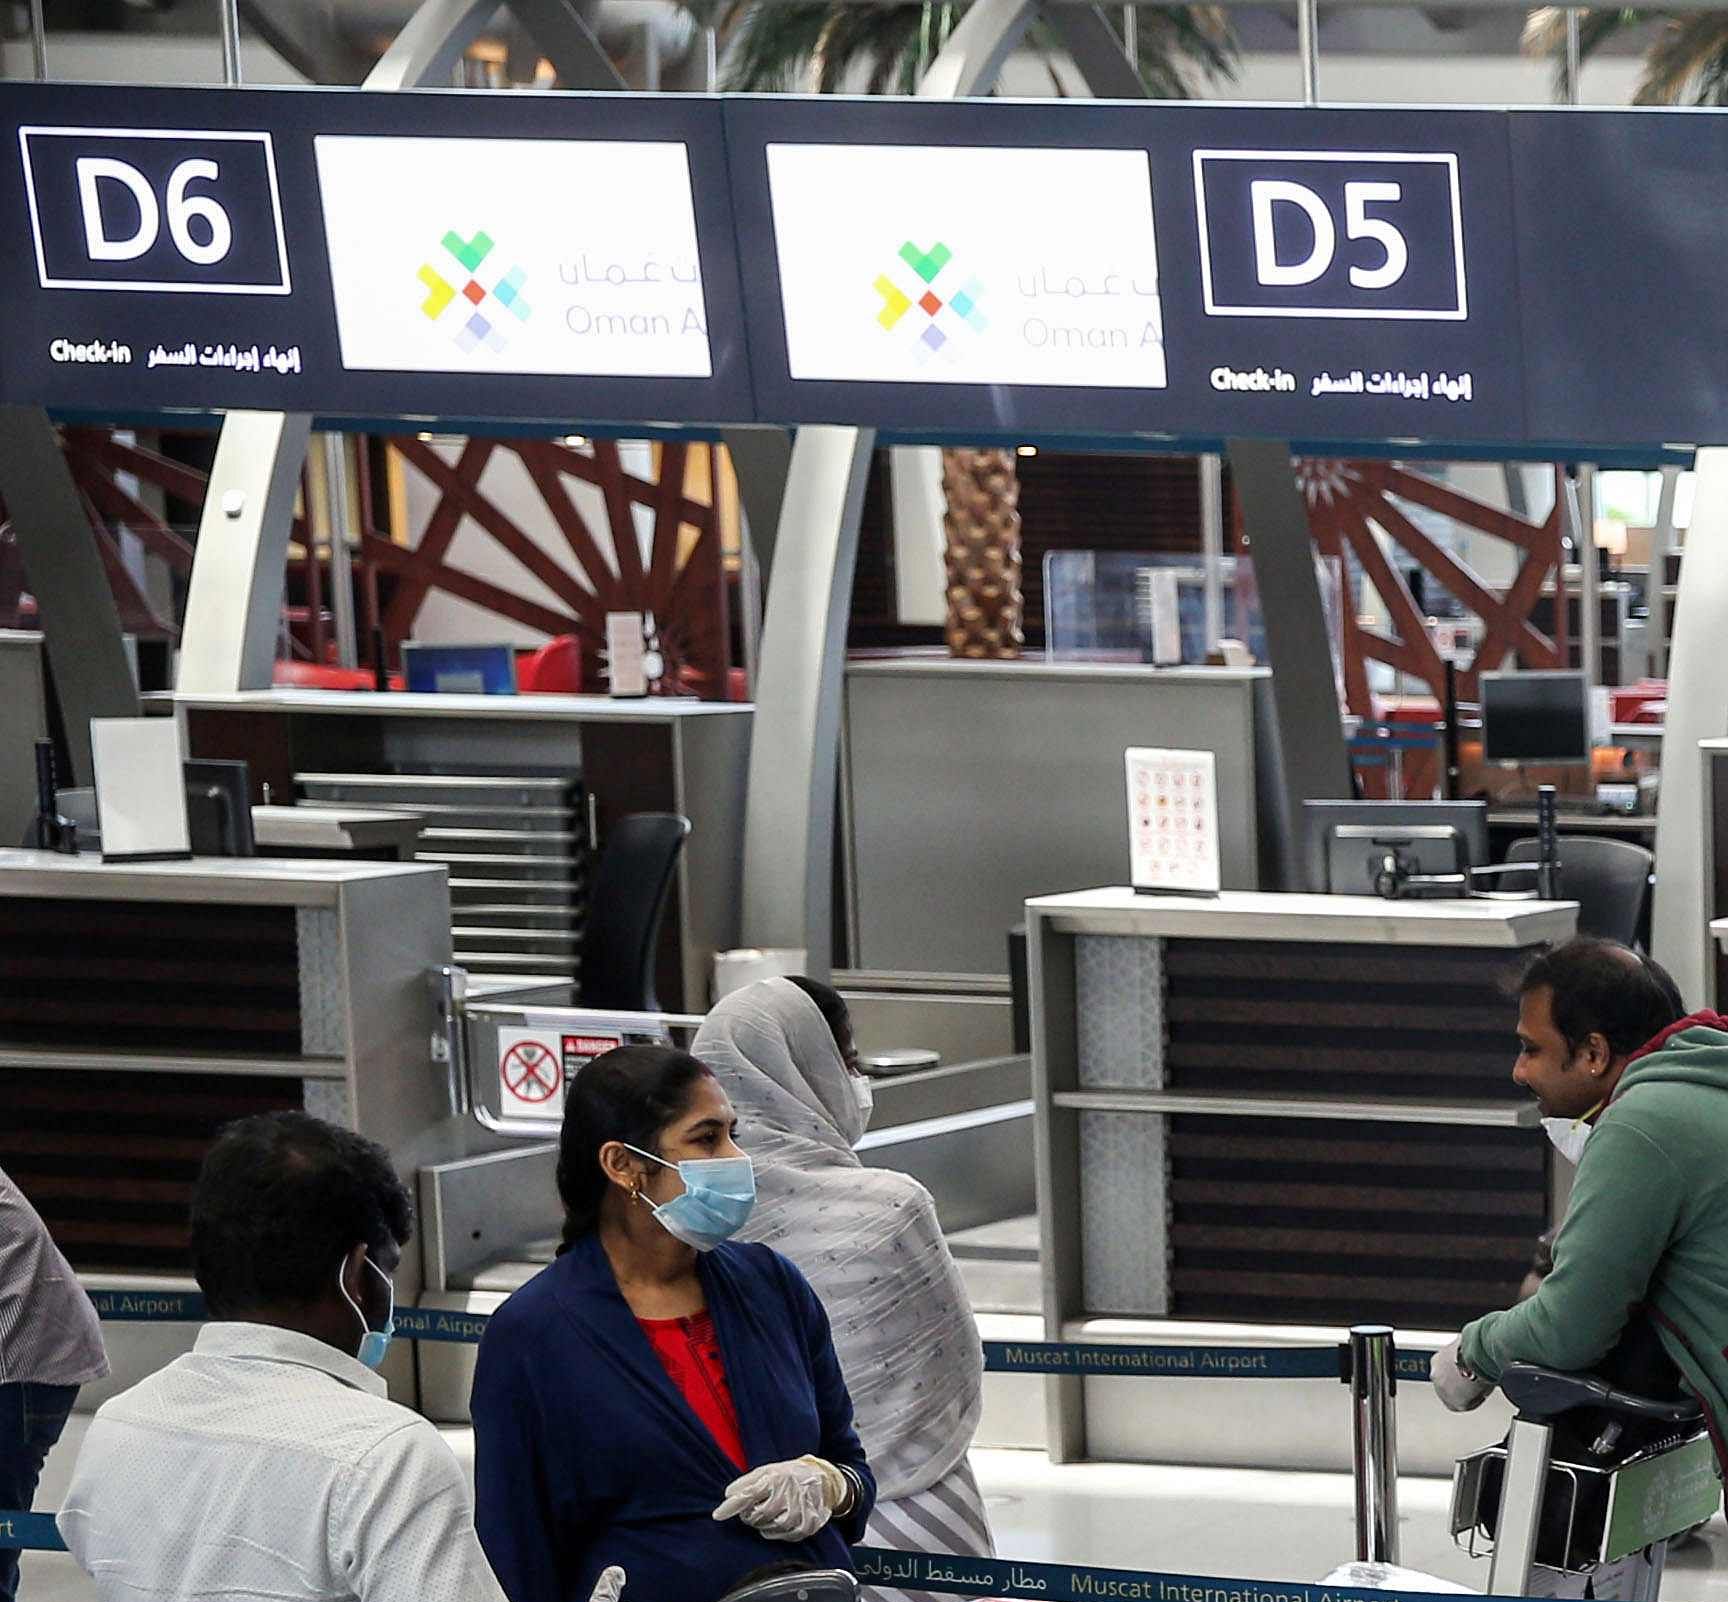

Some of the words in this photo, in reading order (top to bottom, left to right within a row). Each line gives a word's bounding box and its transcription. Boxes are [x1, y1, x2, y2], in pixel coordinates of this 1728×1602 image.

[77, 158, 231, 264] D6
[1251, 181, 1407, 288] D5
[566, 305, 670, 334] Oman
[682, 307, 705, 334] A
[1023, 318, 1128, 347] Oman
[1140, 322, 1161, 348] A
[51, 339, 131, 362] Check-in
[1211, 367, 1295, 390] Check-in
[120, 1296, 183, 1314] Airport
[436, 1317, 488, 1336] Airpo
[1005, 1348, 1071, 1365] Muscat
[1075, 1350, 1194, 1368] International
[1200, 1352, 1268, 1370] Airport
[1396, 1358, 1426, 1373] cat
[925, 1560, 994, 1586] مسقط
[1002, 1567, 1047, 1592] مطار
[1071, 1572, 1150, 1599] Muscat
